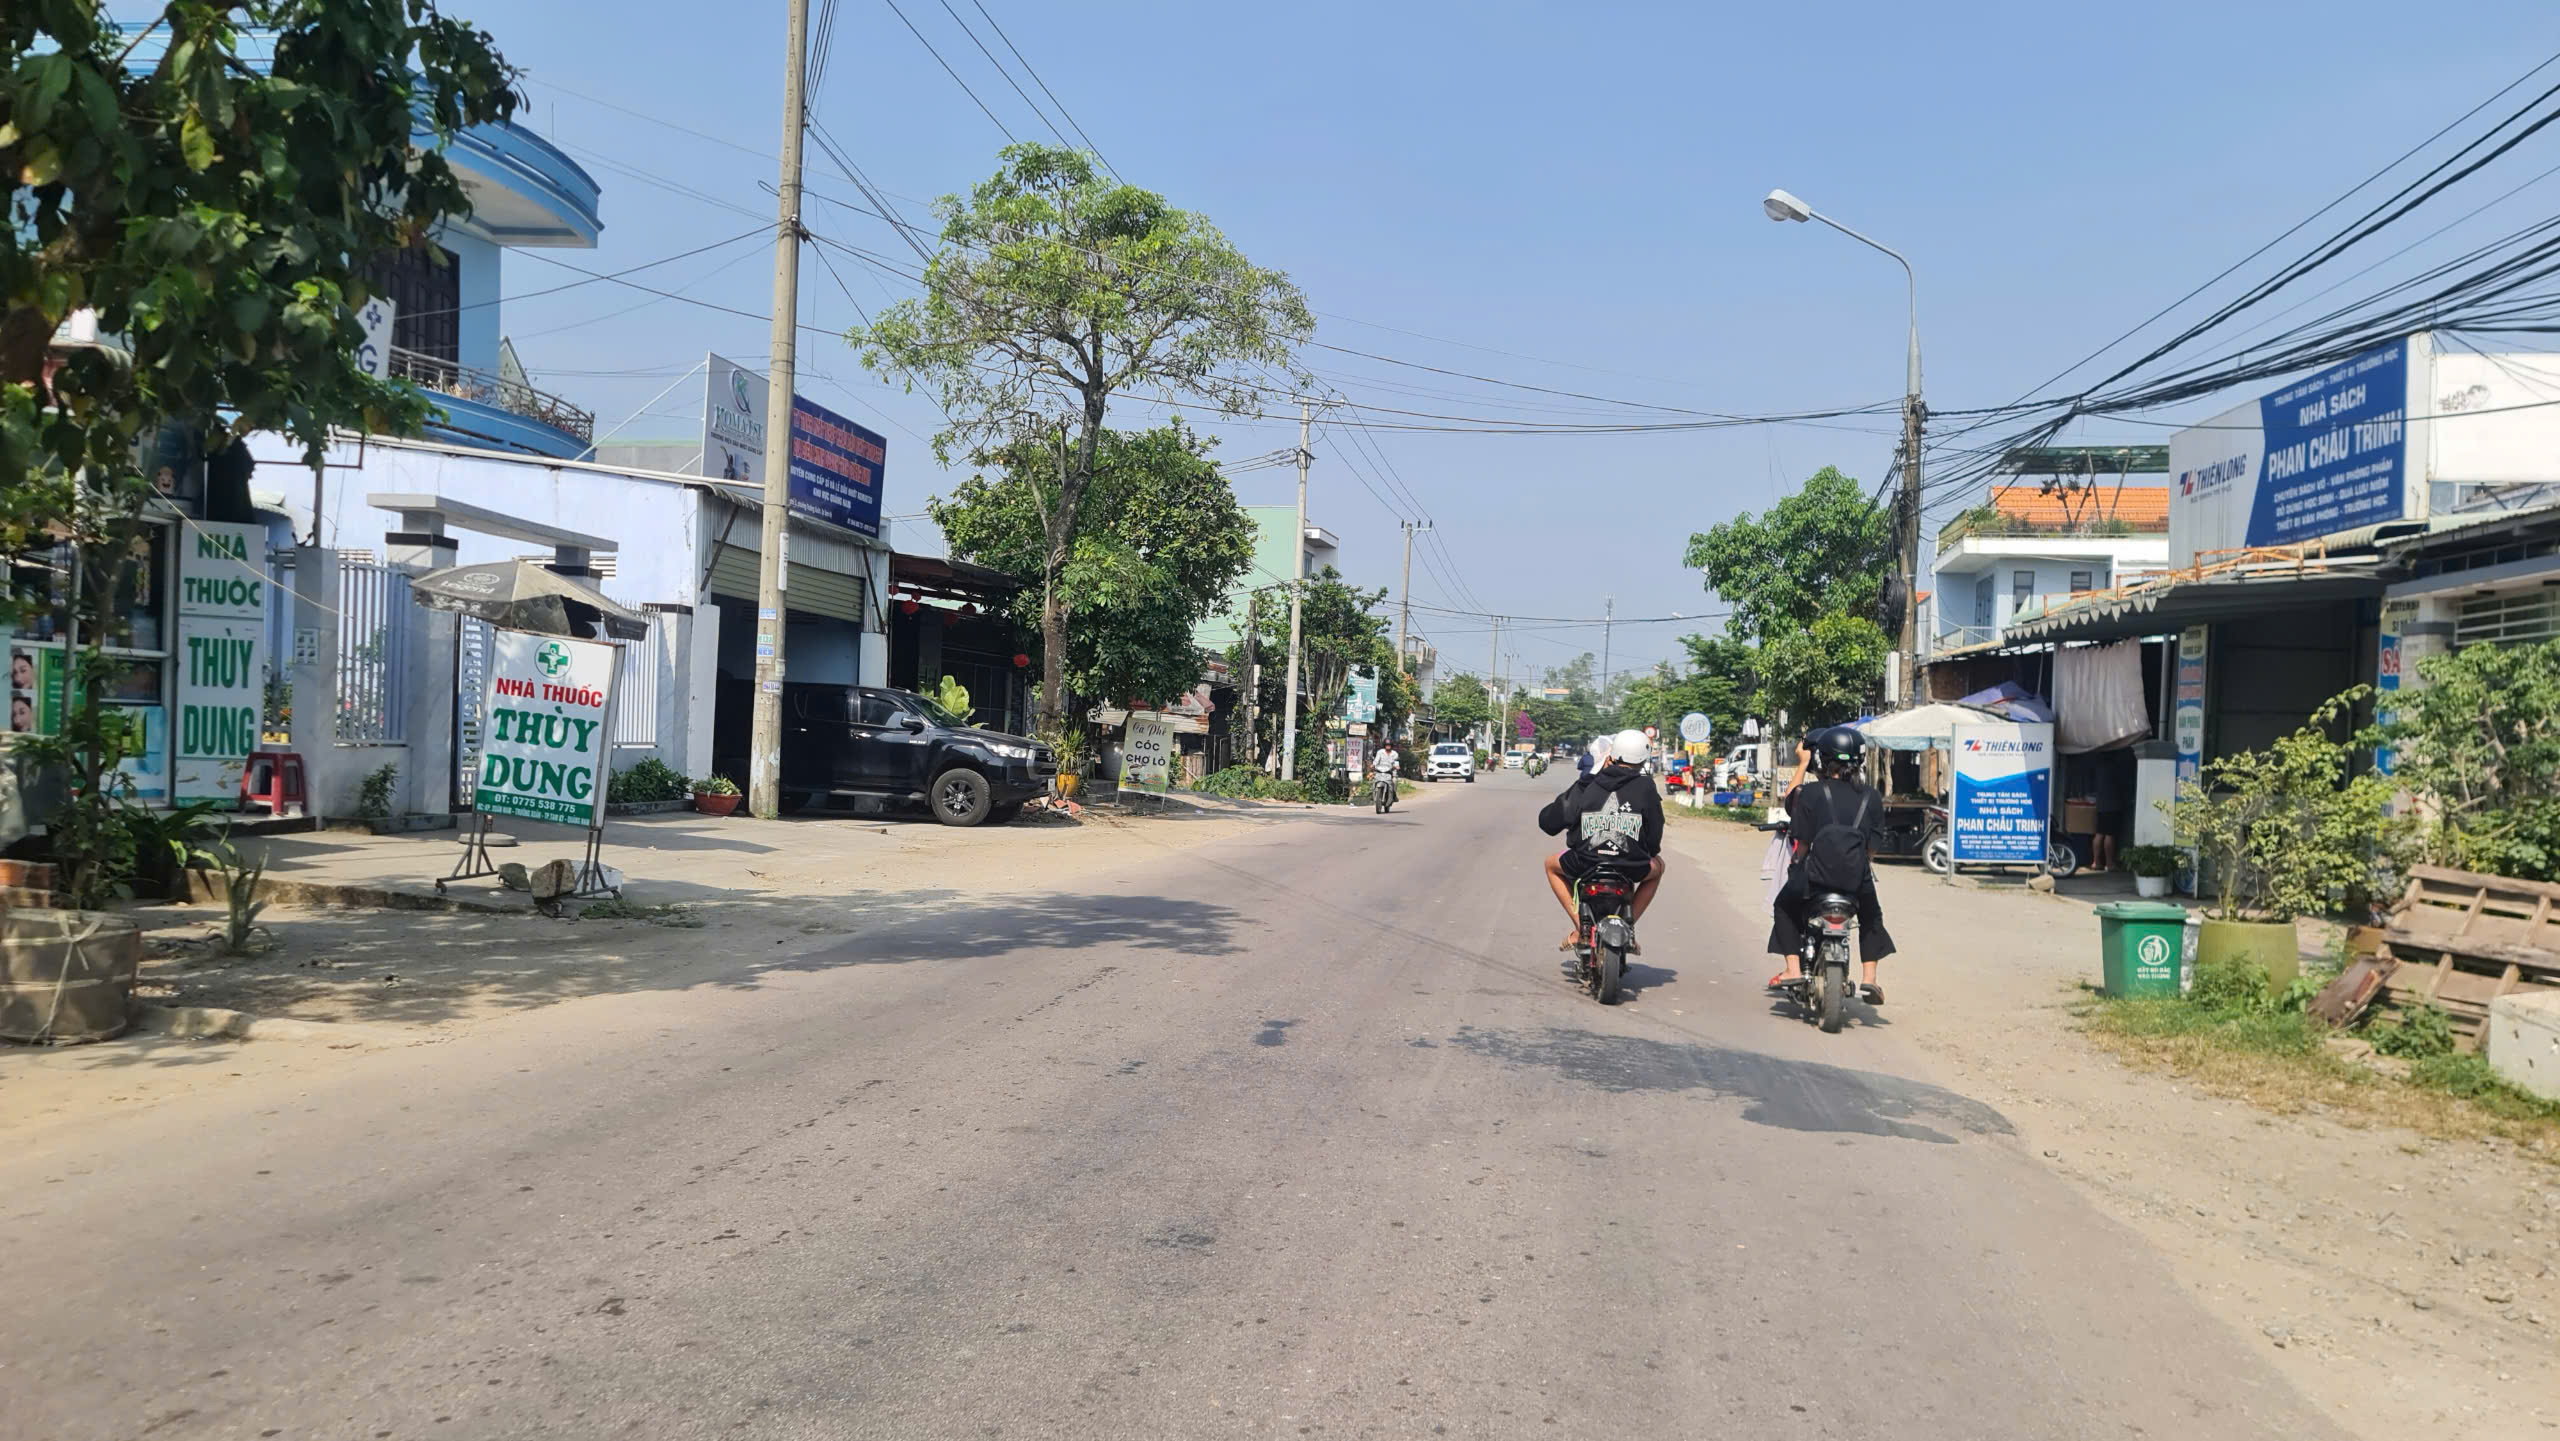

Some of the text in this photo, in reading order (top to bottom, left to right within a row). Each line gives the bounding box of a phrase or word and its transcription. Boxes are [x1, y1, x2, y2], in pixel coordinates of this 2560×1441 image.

[2300, 384, 2366, 426] NHÀ SÁCH
[2268, 408, 2402, 482] PHAN CHÂU TRINH
[197, 532, 248, 561] NHÀ
[184, 574, 261, 607] THUỐC
[188, 627, 254, 689] THÙY
[496, 677, 535, 699] NHÀ
[542, 683, 603, 708] THUỐC
[183, 704, 254, 756] DUNG
[493, 705, 599, 753] THÙY
[482, 753, 592, 799] DUNG
[512, 795, 536, 807] 0775
[537, 799, 556, 810] 538
[558, 803, 576, 813] 775
[1979, 805, 2023, 816] NHÀ SÁCH
[1957, 815, 2045, 833] PHAN CHÂU TRINH
